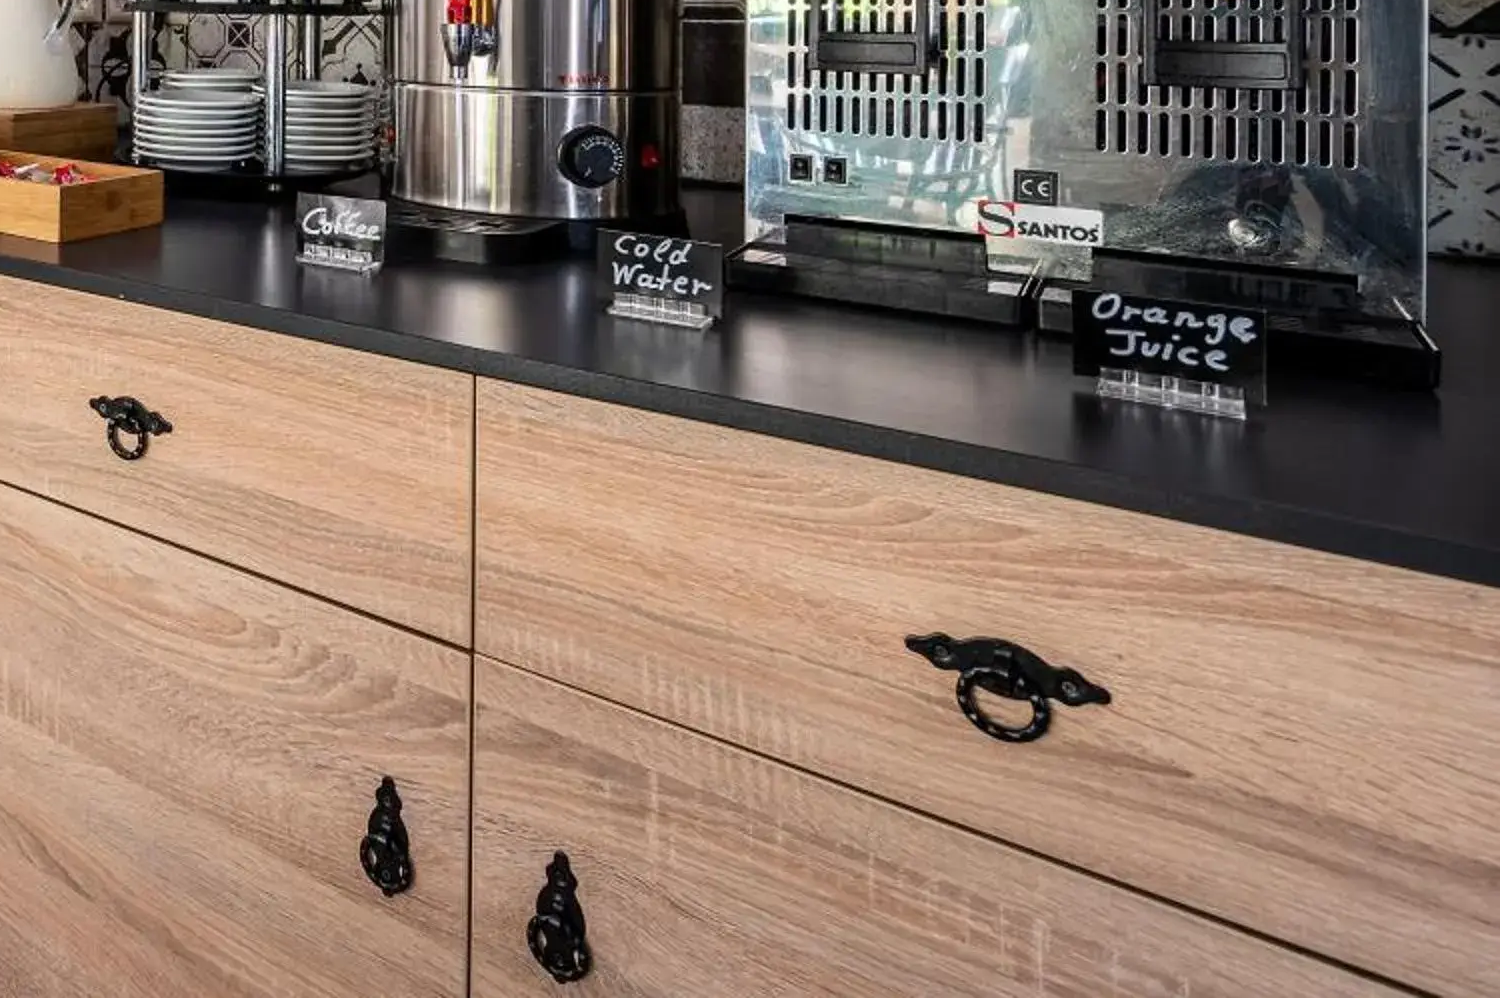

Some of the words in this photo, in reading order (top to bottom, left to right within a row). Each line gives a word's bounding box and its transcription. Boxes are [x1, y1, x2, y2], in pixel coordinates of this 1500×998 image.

[1021, 179, 1051, 197] CE
[301, 207, 381, 241] Coffee
[1018, 221, 1099, 243] SANTOS
[614, 235, 693, 265] Cold
[611, 261, 713, 297] Water
[1091, 293, 1257, 345] Orange
[1105, 328, 1230, 372] Juice
